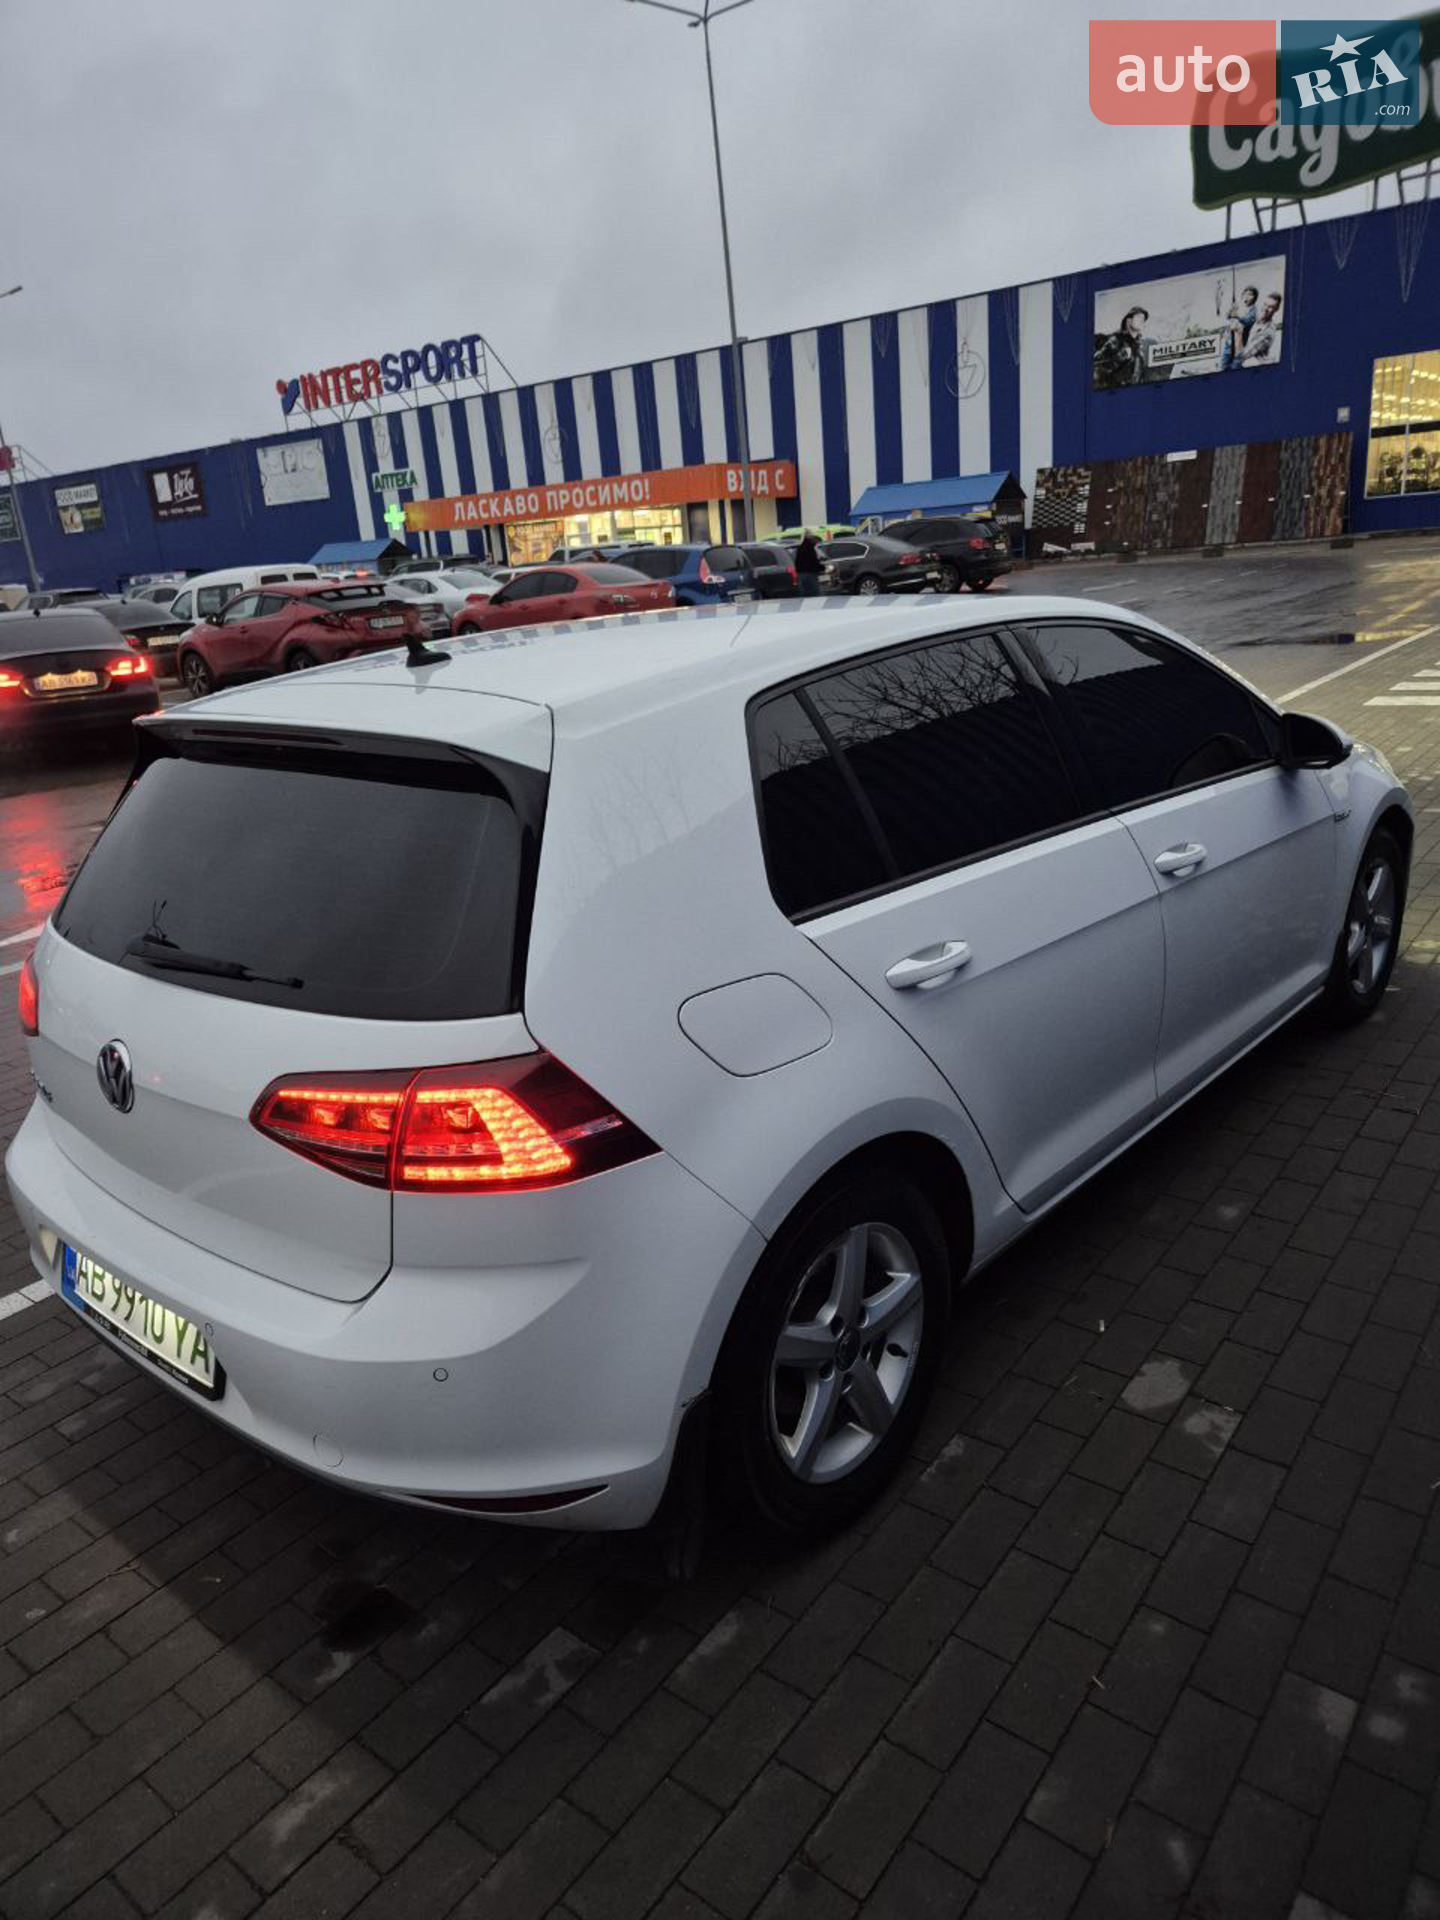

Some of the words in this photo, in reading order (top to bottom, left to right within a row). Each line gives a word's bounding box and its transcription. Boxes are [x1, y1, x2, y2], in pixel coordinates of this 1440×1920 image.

[1207, 30, 1440, 188] Садов
[1153, 339, 1216, 355] MILITARY
[300, 334, 481, 409] INTERSPORT
[373, 471, 418, 491] АПТЕКА
[454, 493, 540, 522] ЛАСКАВО
[546, 478, 650, 512] ПРОСИМО!
[774, 469, 786, 490] С
[77, 1253, 106, 1302] AB
